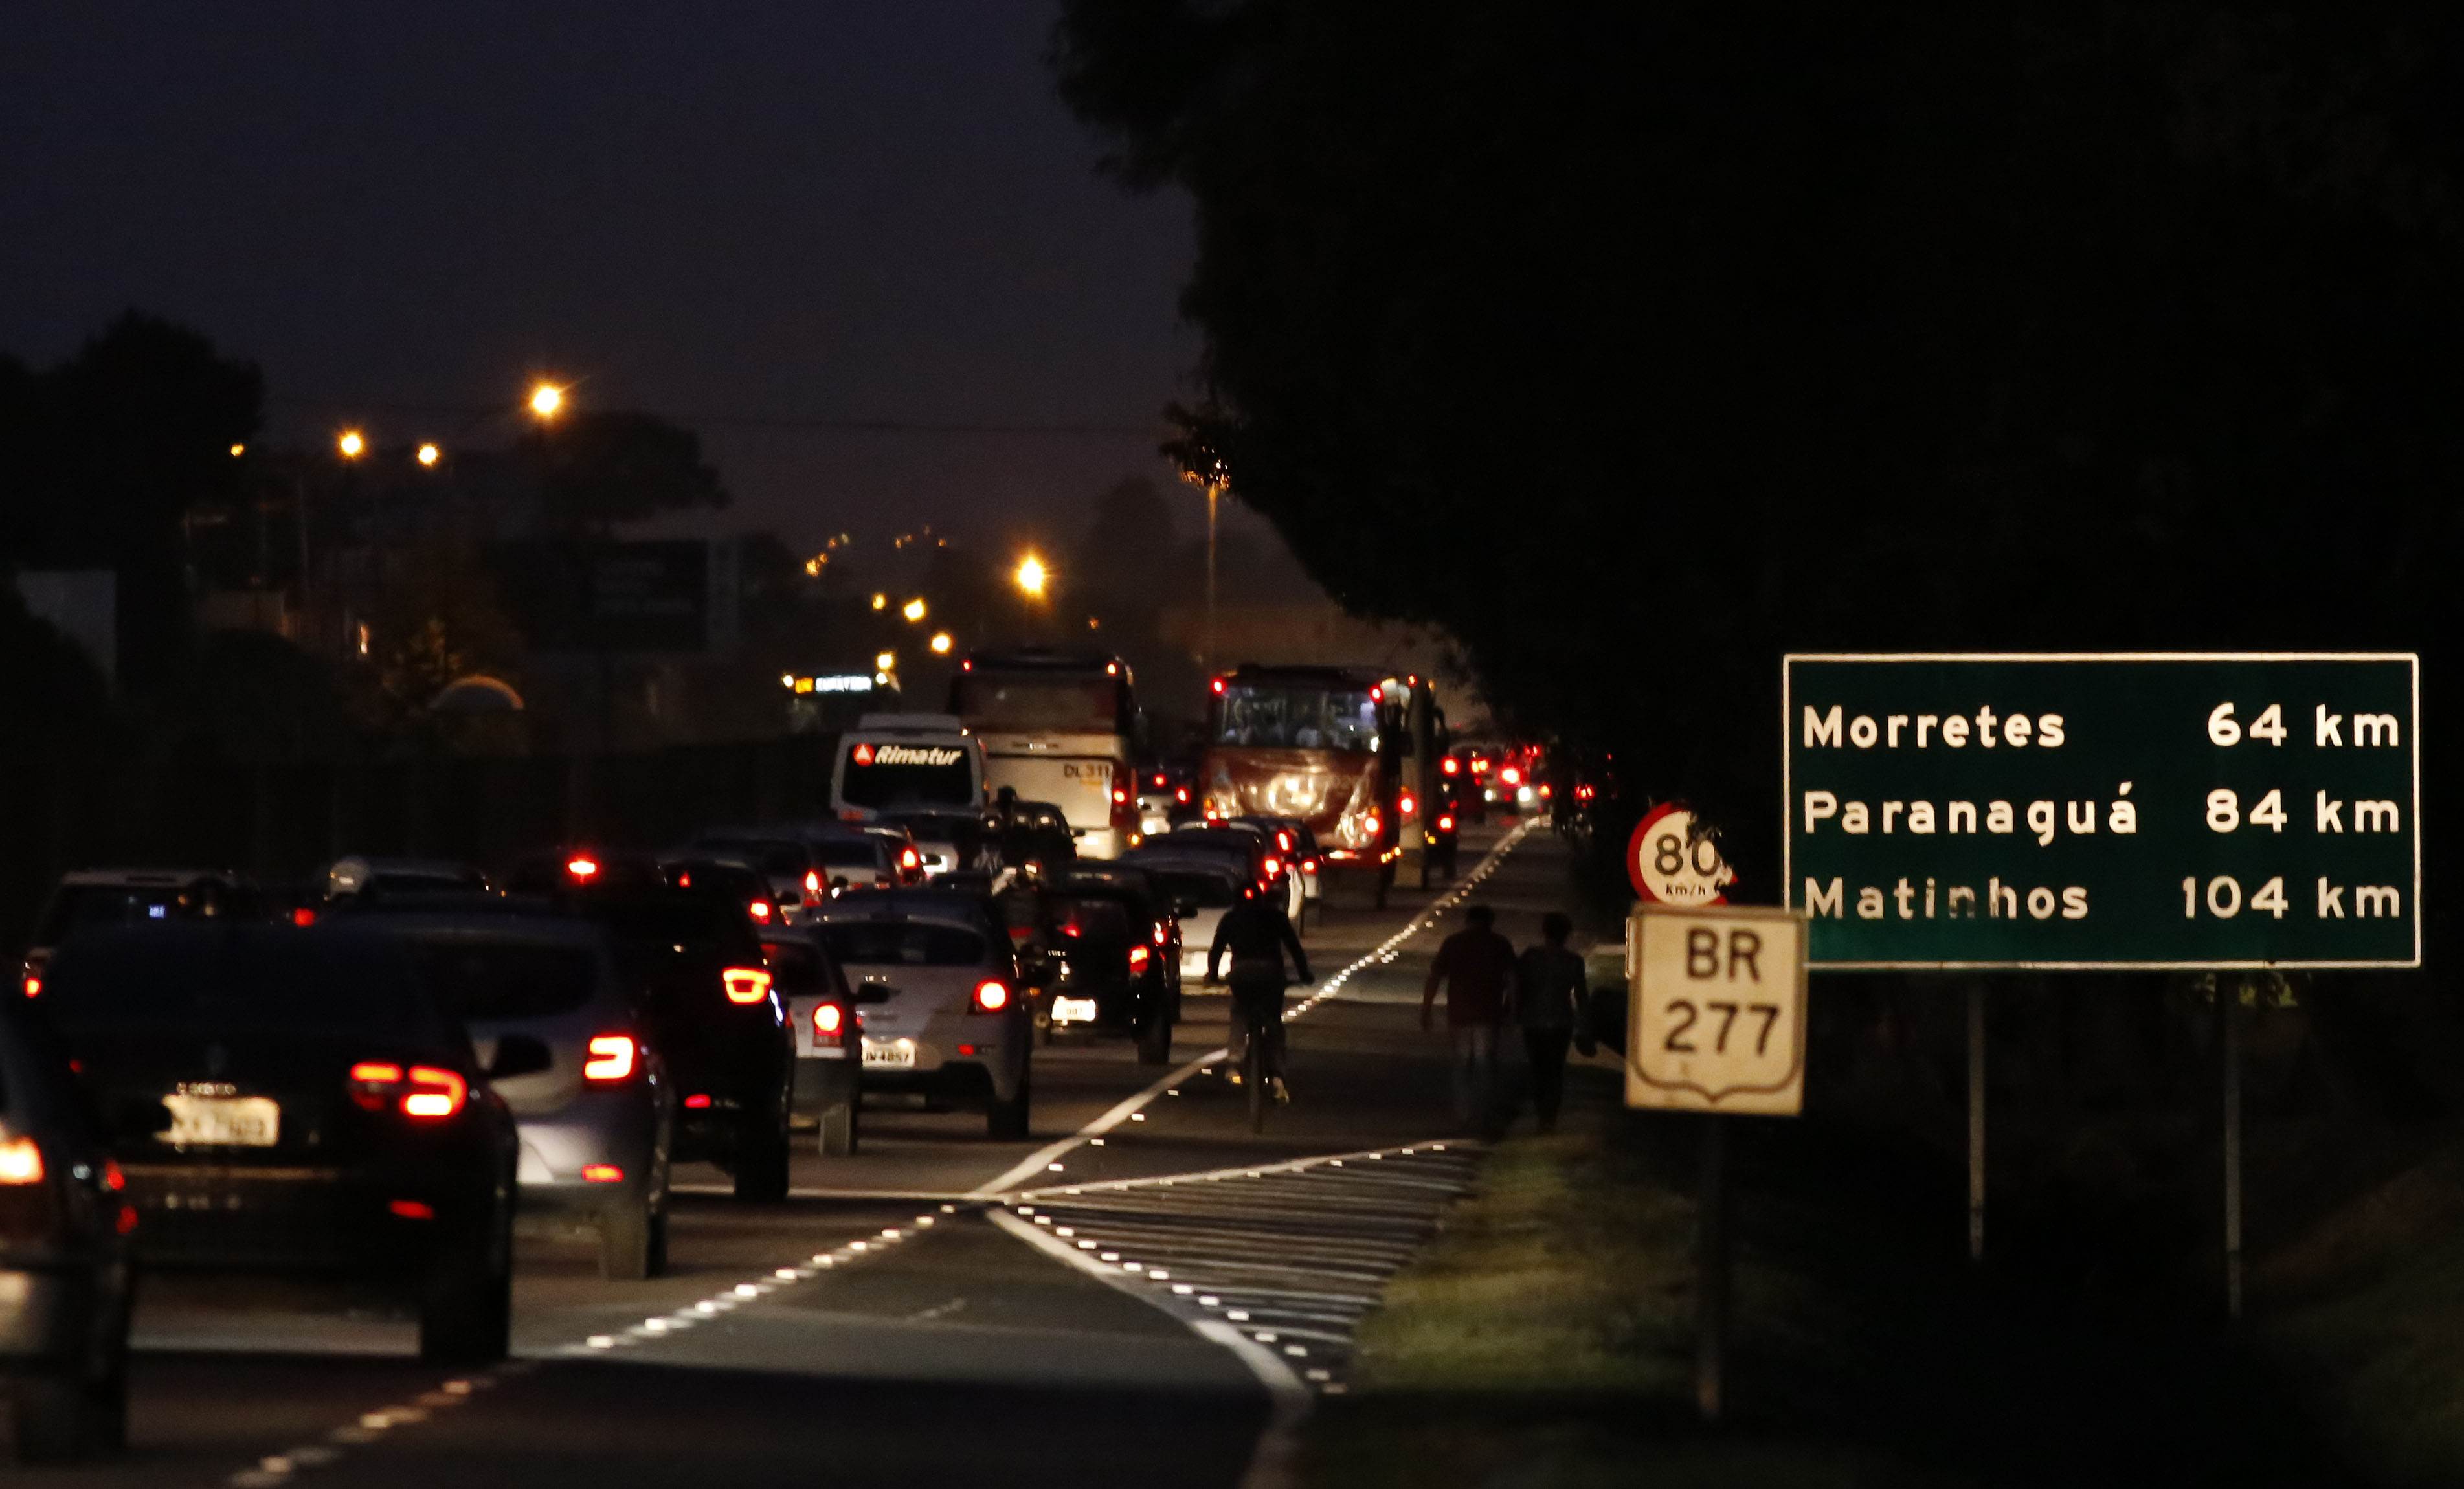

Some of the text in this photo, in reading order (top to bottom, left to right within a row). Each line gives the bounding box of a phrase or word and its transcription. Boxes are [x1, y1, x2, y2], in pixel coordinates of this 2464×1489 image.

[1803, 702, 2399, 748] Morretes 64 km
[875, 745, 962, 765] Rimatur
[1804, 781, 2399, 847] Paranaguá 84 km
[1655, 833, 1721, 877] 80
[1666, 884, 1706, 896] km/h
[1805, 875, 2400, 919] Matinhos 104 km
[1687, 929, 1761, 982] BR
[1664, 999, 1779, 1055] 277
